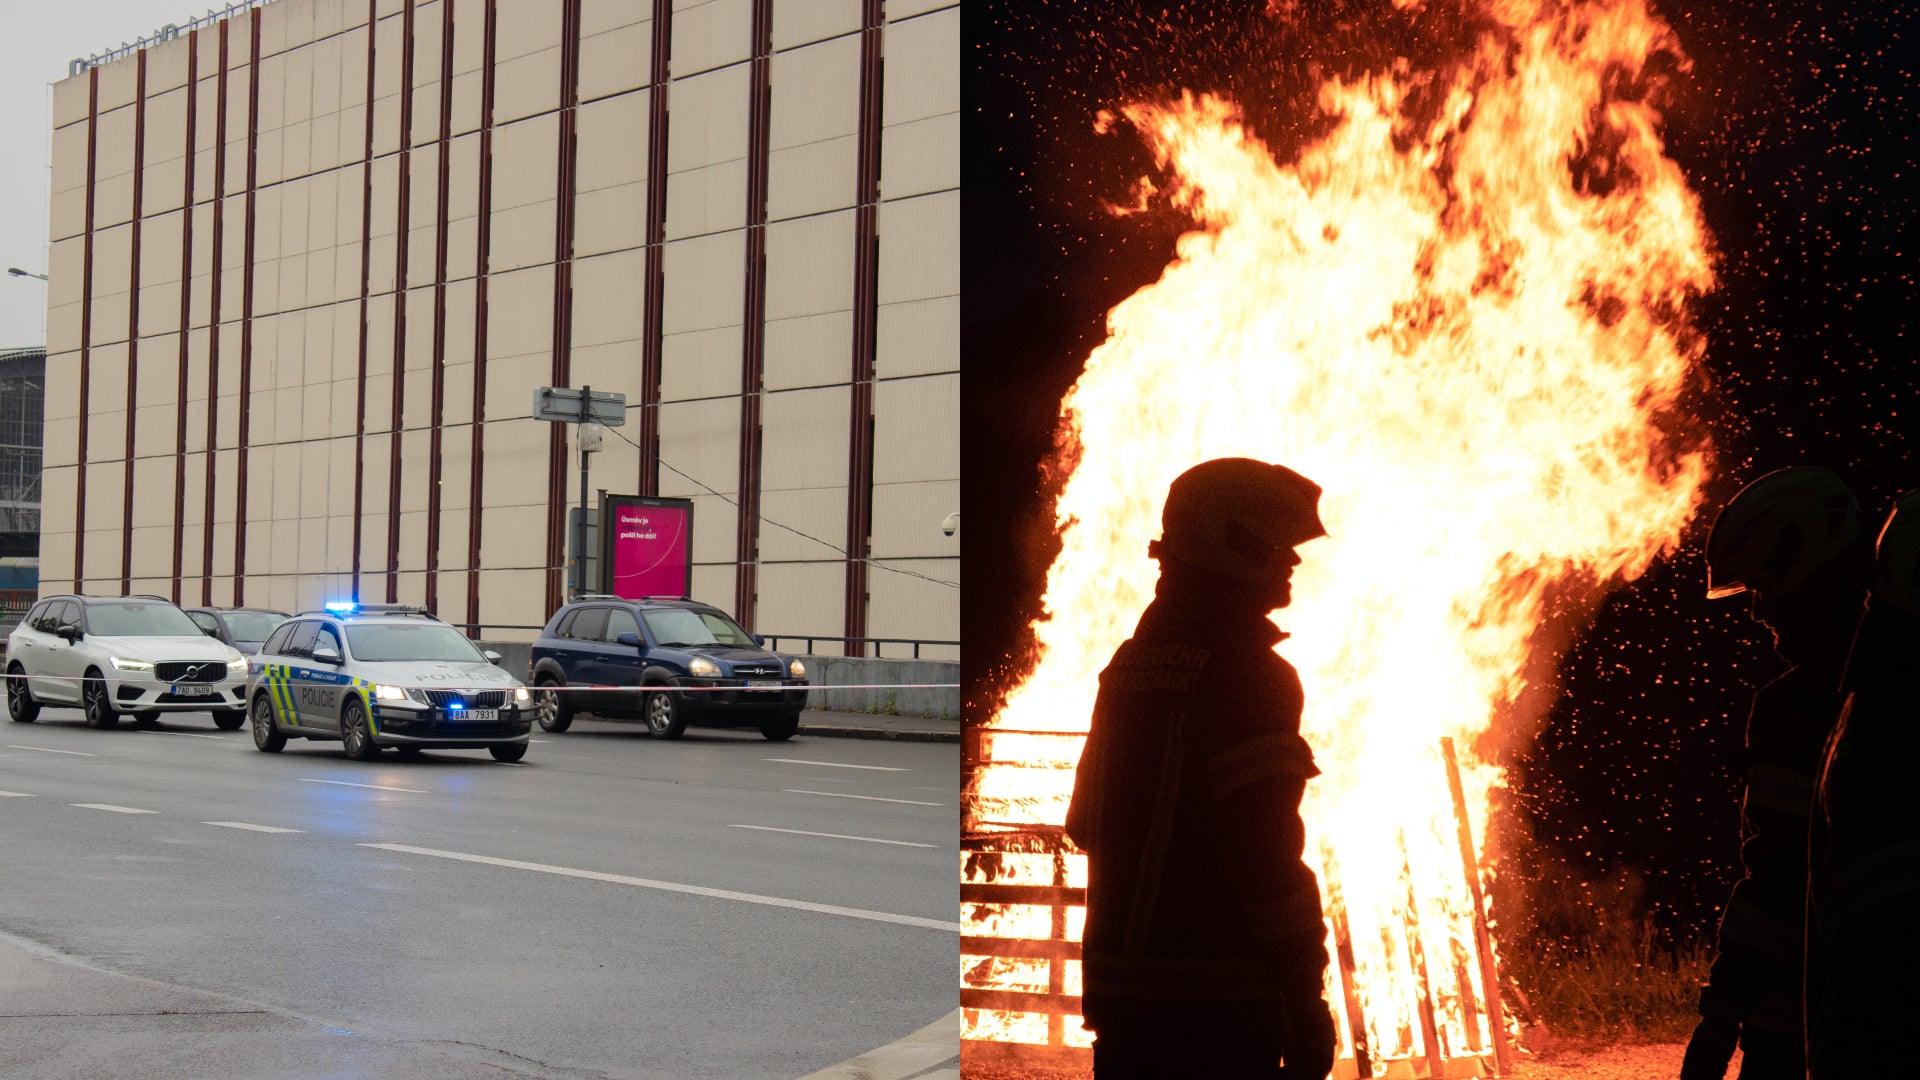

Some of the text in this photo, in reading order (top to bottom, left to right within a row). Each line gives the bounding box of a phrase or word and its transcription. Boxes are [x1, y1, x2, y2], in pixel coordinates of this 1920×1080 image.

[302, 688, 335, 708] POLICIE
[455, 710, 494, 719] 8AA 7931
